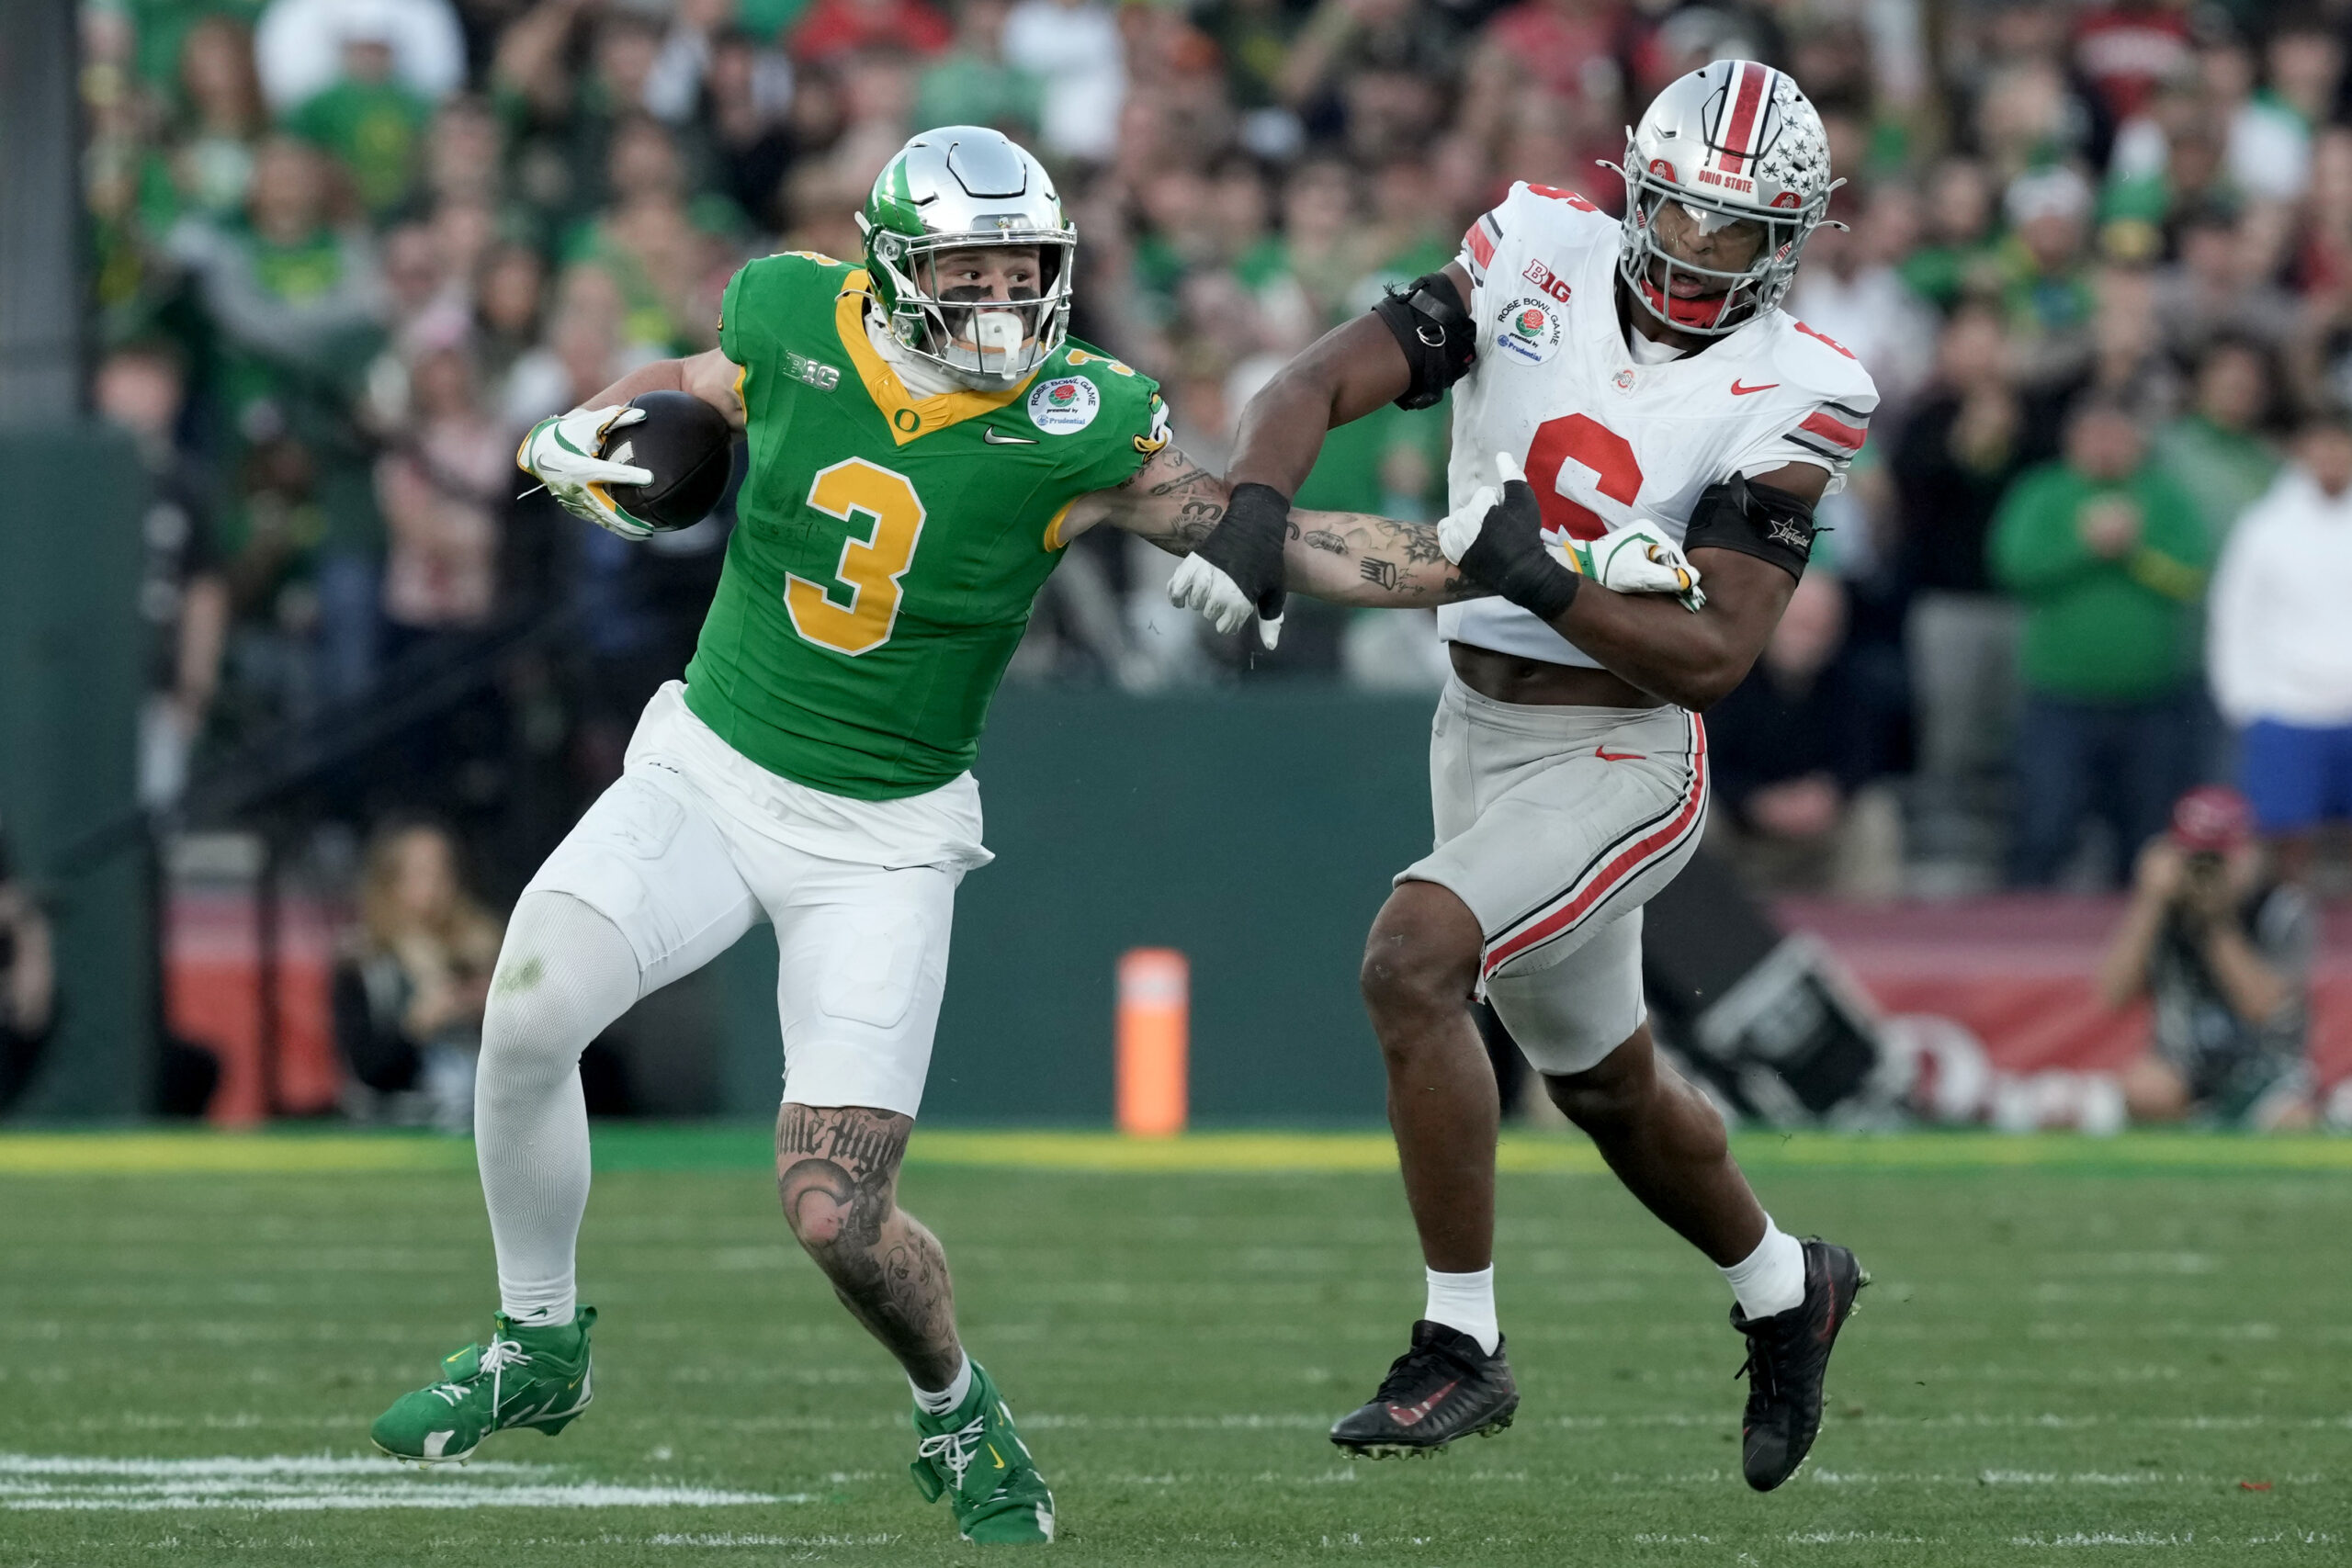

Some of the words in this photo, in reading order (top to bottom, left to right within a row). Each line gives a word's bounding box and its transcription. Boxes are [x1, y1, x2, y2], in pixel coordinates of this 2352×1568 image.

[1699, 170, 1722, 186] OHIO
[1724, 175, 1753, 193] STATE
[1498, 299, 1521, 322] ROSE
[1523, 298, 1550, 316] BOWL
[1551, 314, 1561, 346] GAME
[1508, 341, 1542, 362] Prudential
[1509, 332, 1532, 344] presented
[1532, 340, 1539, 348] by
[1031, 384, 1049, 406] ROSE
[1050, 378, 1080, 387] BOWL
[1080, 381, 1096, 406] GAME
[1049, 417, 1086, 425] Prudential
[784, 456, 926, 657] 3
